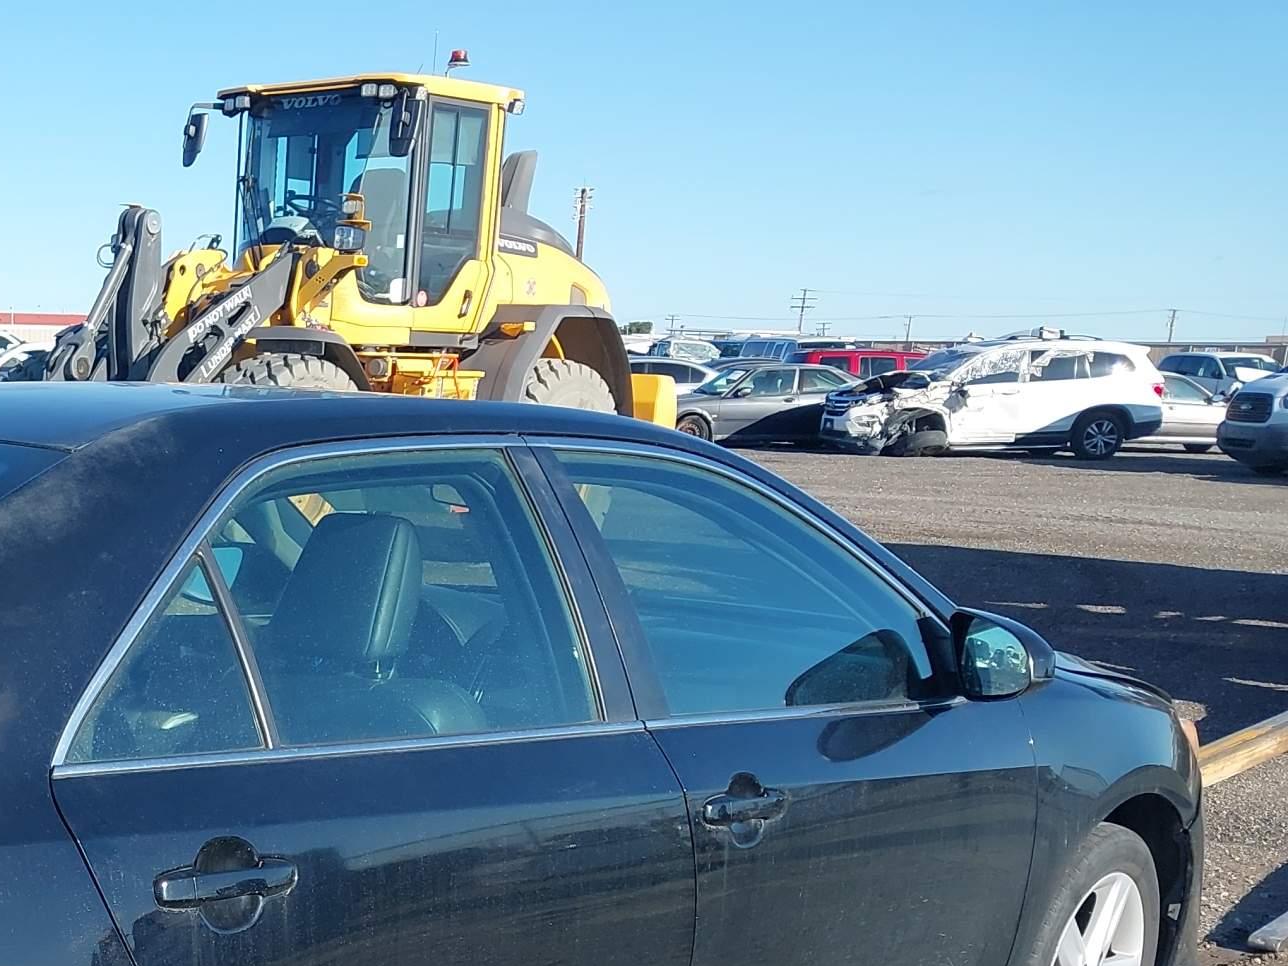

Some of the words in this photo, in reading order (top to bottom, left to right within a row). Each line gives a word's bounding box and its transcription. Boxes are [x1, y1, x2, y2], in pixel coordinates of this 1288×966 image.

[281, 94, 341, 110] VOLVO
[498, 239, 536, 253] VOLVO
[189, 322, 205, 340] DO
[204, 308, 225, 326] NOT
[224, 286, 251, 312] WALK
[207, 337, 235, 368] UNDER
[234, 312, 258, 337] MAST
